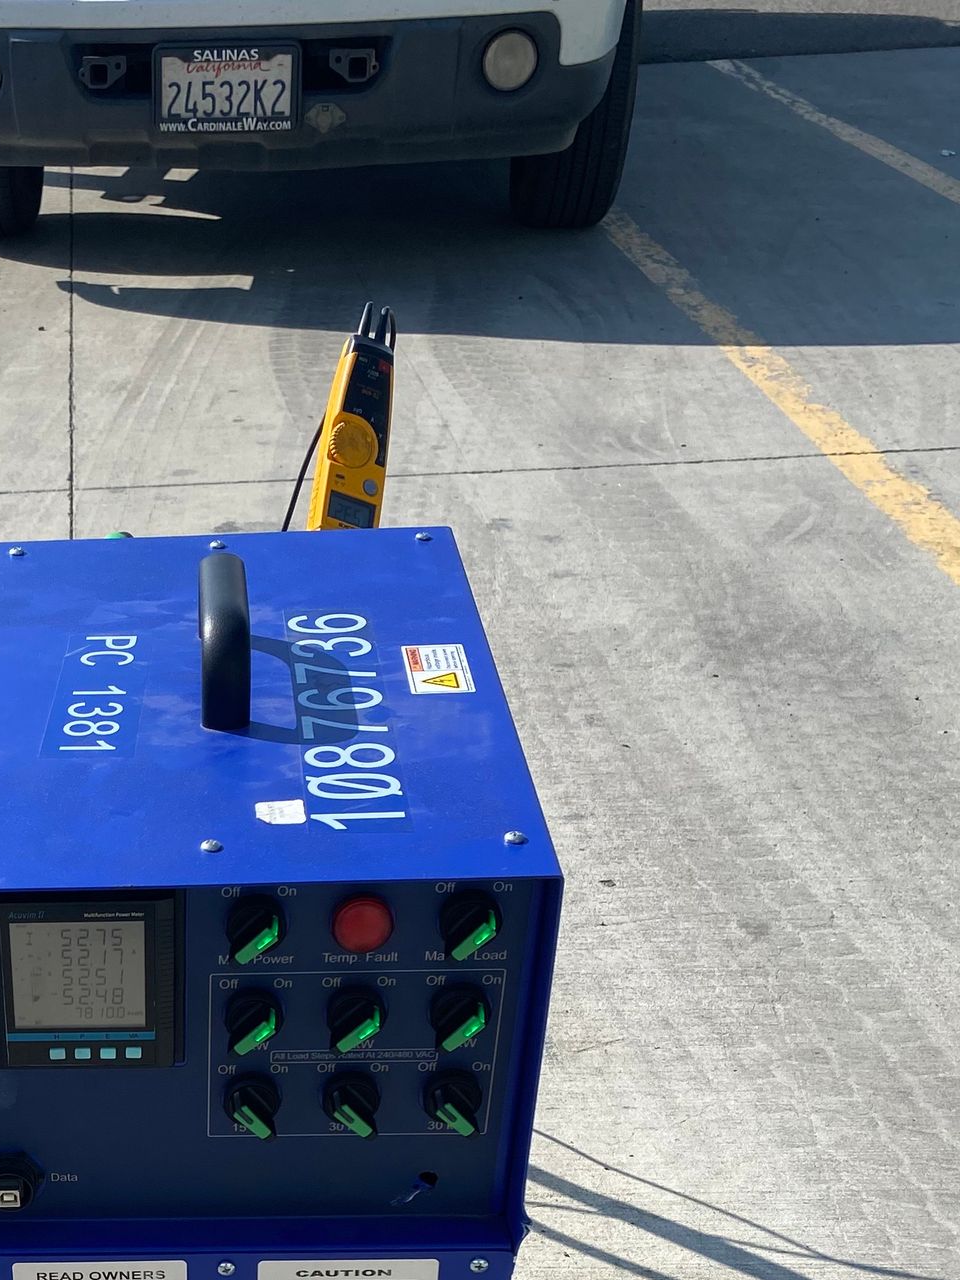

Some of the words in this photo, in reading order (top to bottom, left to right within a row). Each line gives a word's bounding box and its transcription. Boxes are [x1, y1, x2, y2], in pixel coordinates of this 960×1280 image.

[193, 49, 259, 62] SALINAS
[187, 61, 270, 79] California
[167, 79, 287, 118] 24532K2
[80, 635, 137, 666] PC
[59, 685, 127, 750] 1381
[221, 886, 241, 898] Off
[277, 885, 297, 897] On
[435, 882, 456, 893] Off
[493, 881, 513, 892] On
[8, 911, 37, 920] Acuvim
[61, 928, 123, 947] 52.75
[253, 955, 294, 965] Power
[366, 952, 398, 962] Fault
[474, 950, 507, 961] Load
[219, 978, 239, 989] Off
[273, 978, 293, 988] On
[322, 977, 342, 988] Off
[377, 976, 397, 986] On
[426, 975, 447, 986] Off
[482, 975, 502, 985] On
[63, 988, 124, 1005] 52.48
[287, 1052, 308, 1060] Load
[218, 1064, 237, 1075] Off
[270, 1064, 289, 1074] On
[317, 1063, 337, 1074] Off
[370, 1062, 389, 1073] On
[418, 1062, 437, 1072] Off
[472, 1061, 491, 1072] On
[51, 1173, 78, 1182] Data
[89, 1270, 166, 1280] OWNERS
[295, 1269, 392, 1278] CAUTION
